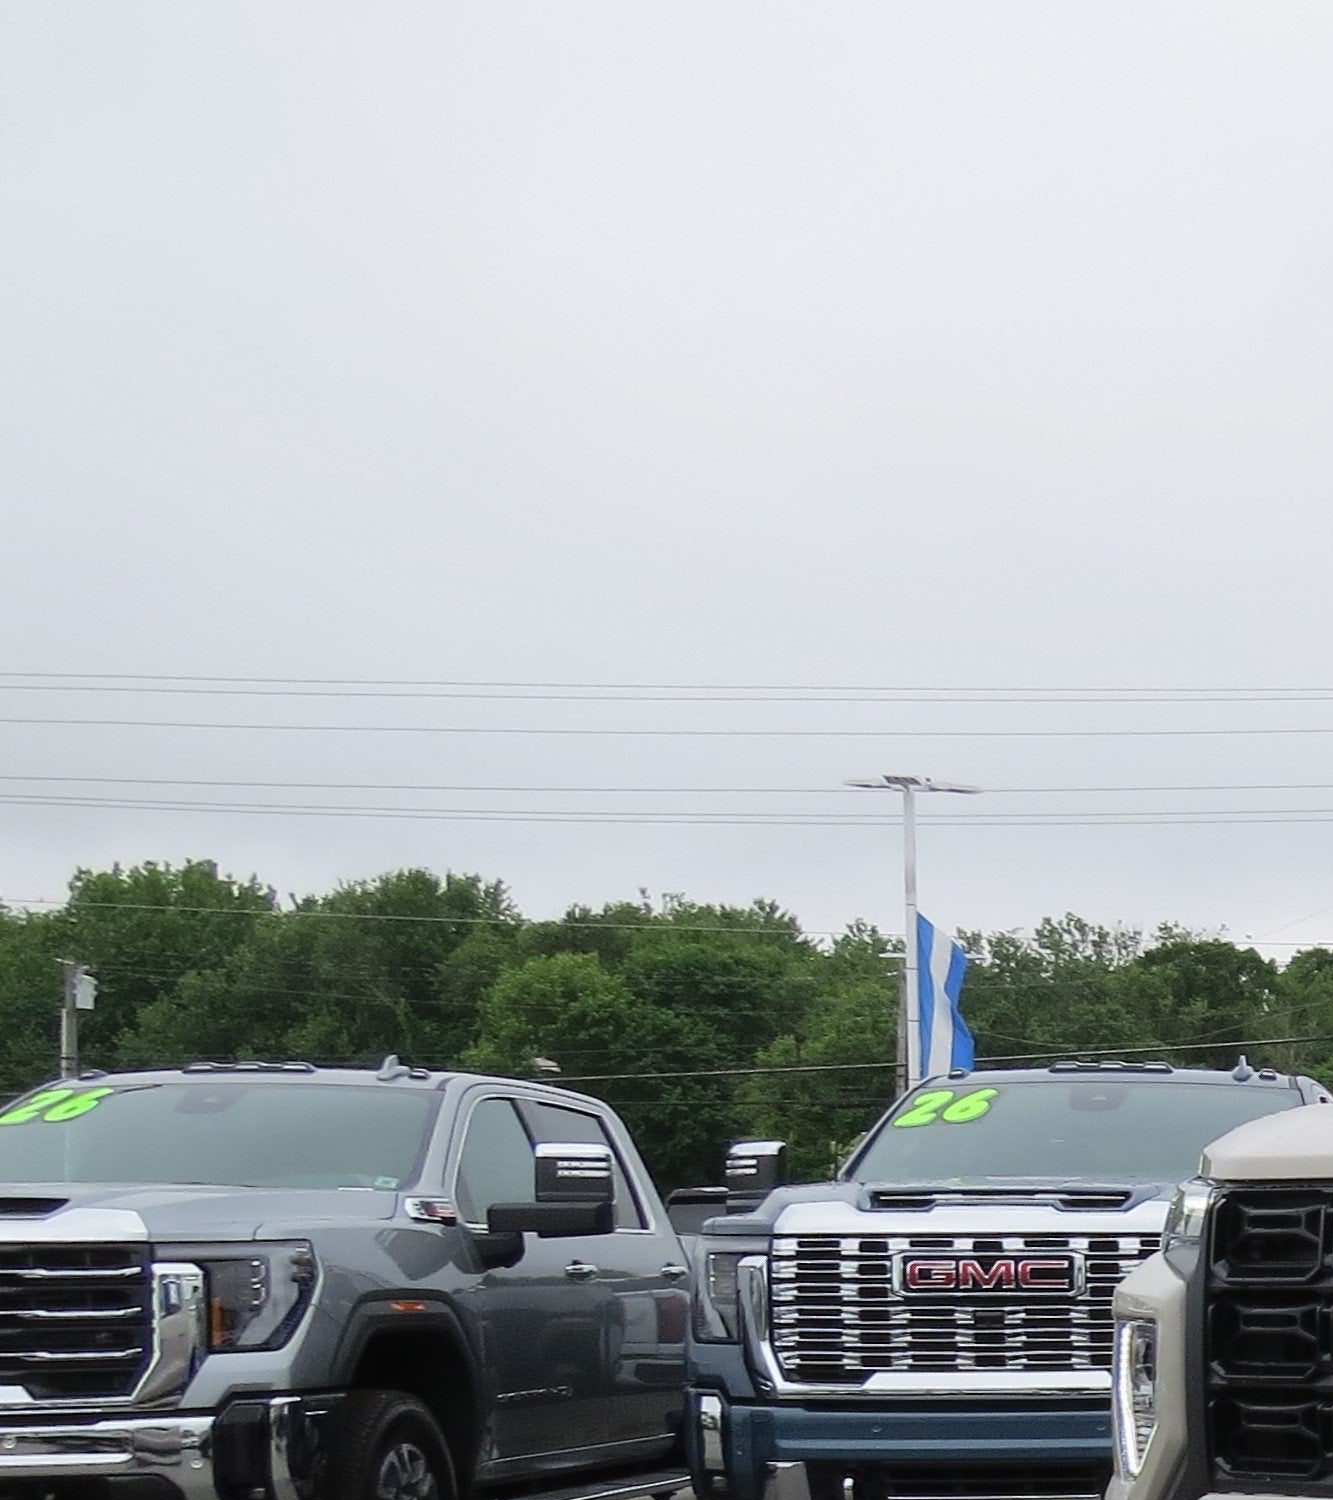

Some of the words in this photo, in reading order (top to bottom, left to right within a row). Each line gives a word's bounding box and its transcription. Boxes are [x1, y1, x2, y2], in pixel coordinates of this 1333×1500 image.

[0, 1087, 115, 1125] 26
[892, 1087, 999, 1128] 26
[905, 1259, 1070, 1289] GMC
